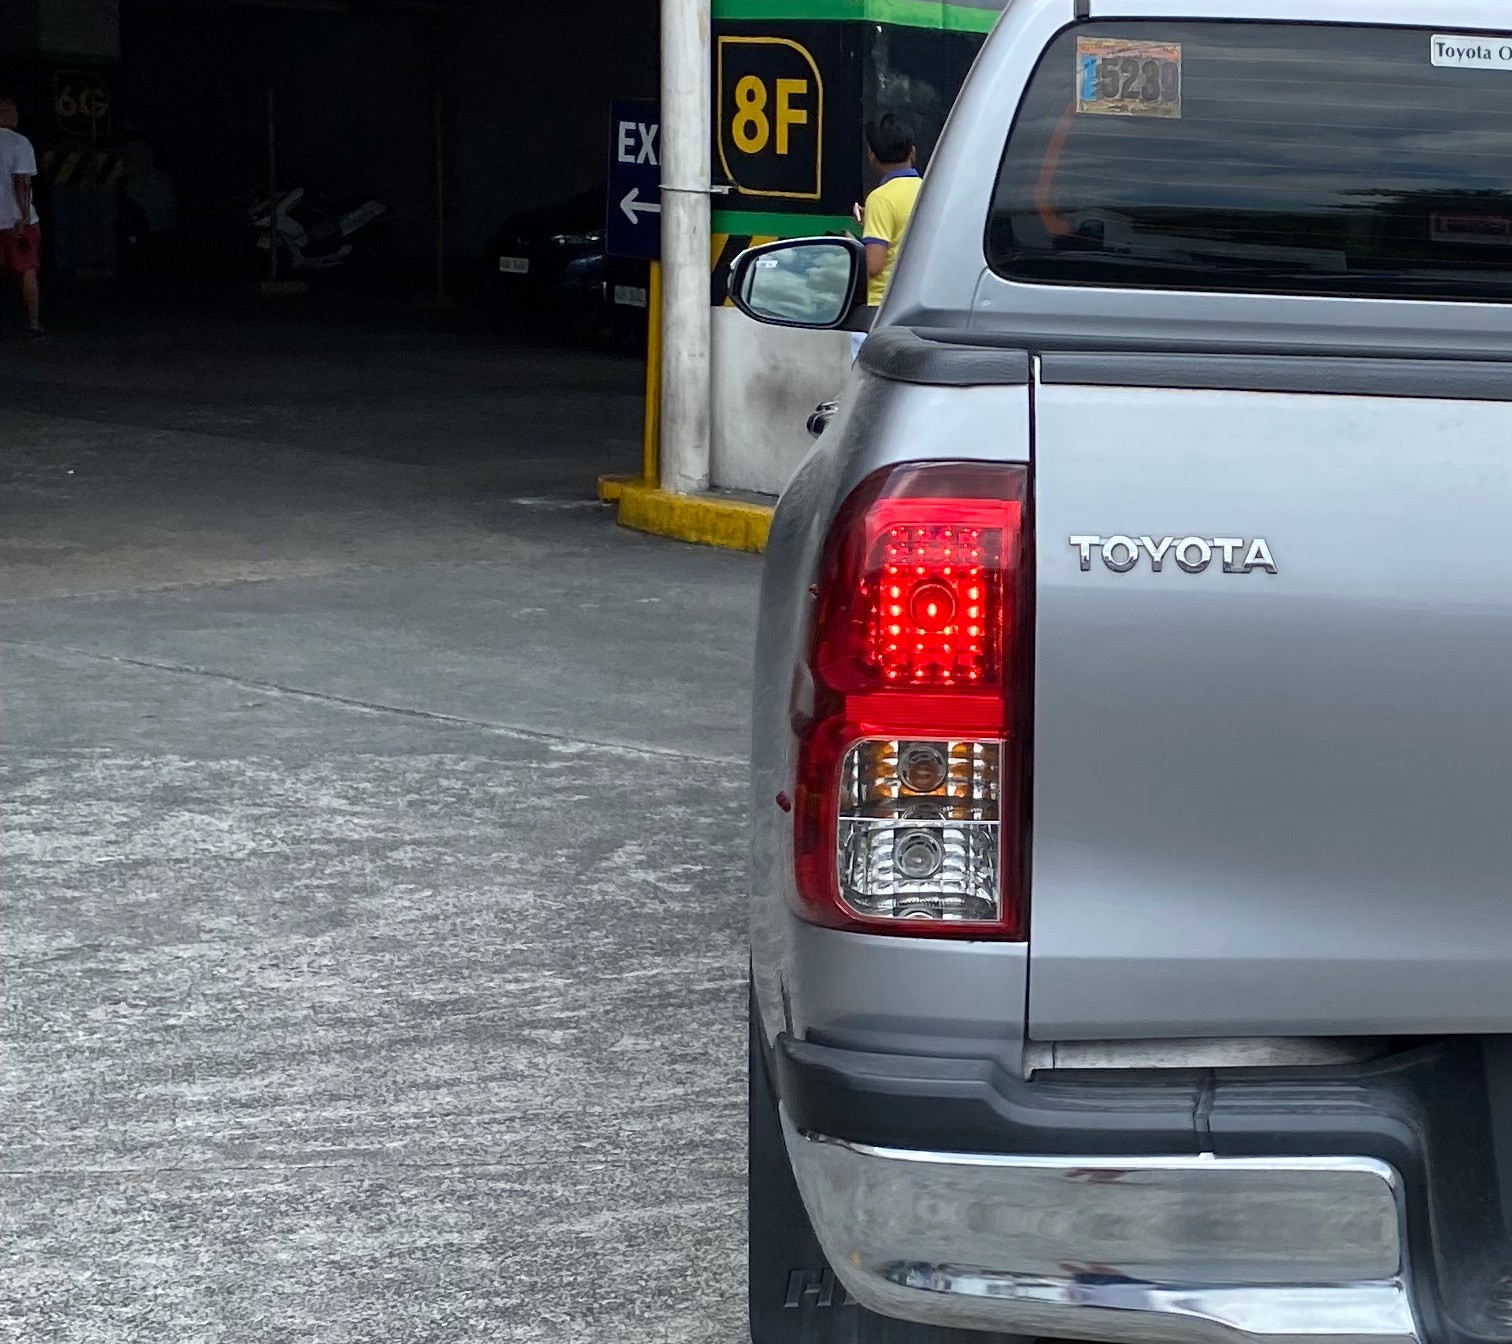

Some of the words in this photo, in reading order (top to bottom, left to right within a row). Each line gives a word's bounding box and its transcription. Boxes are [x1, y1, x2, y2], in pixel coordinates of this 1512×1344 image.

[1435, 41, 1493, 63] Toyota
[732, 75, 808, 155] 8F
[1069, 534, 1278, 574] TOYOTA
